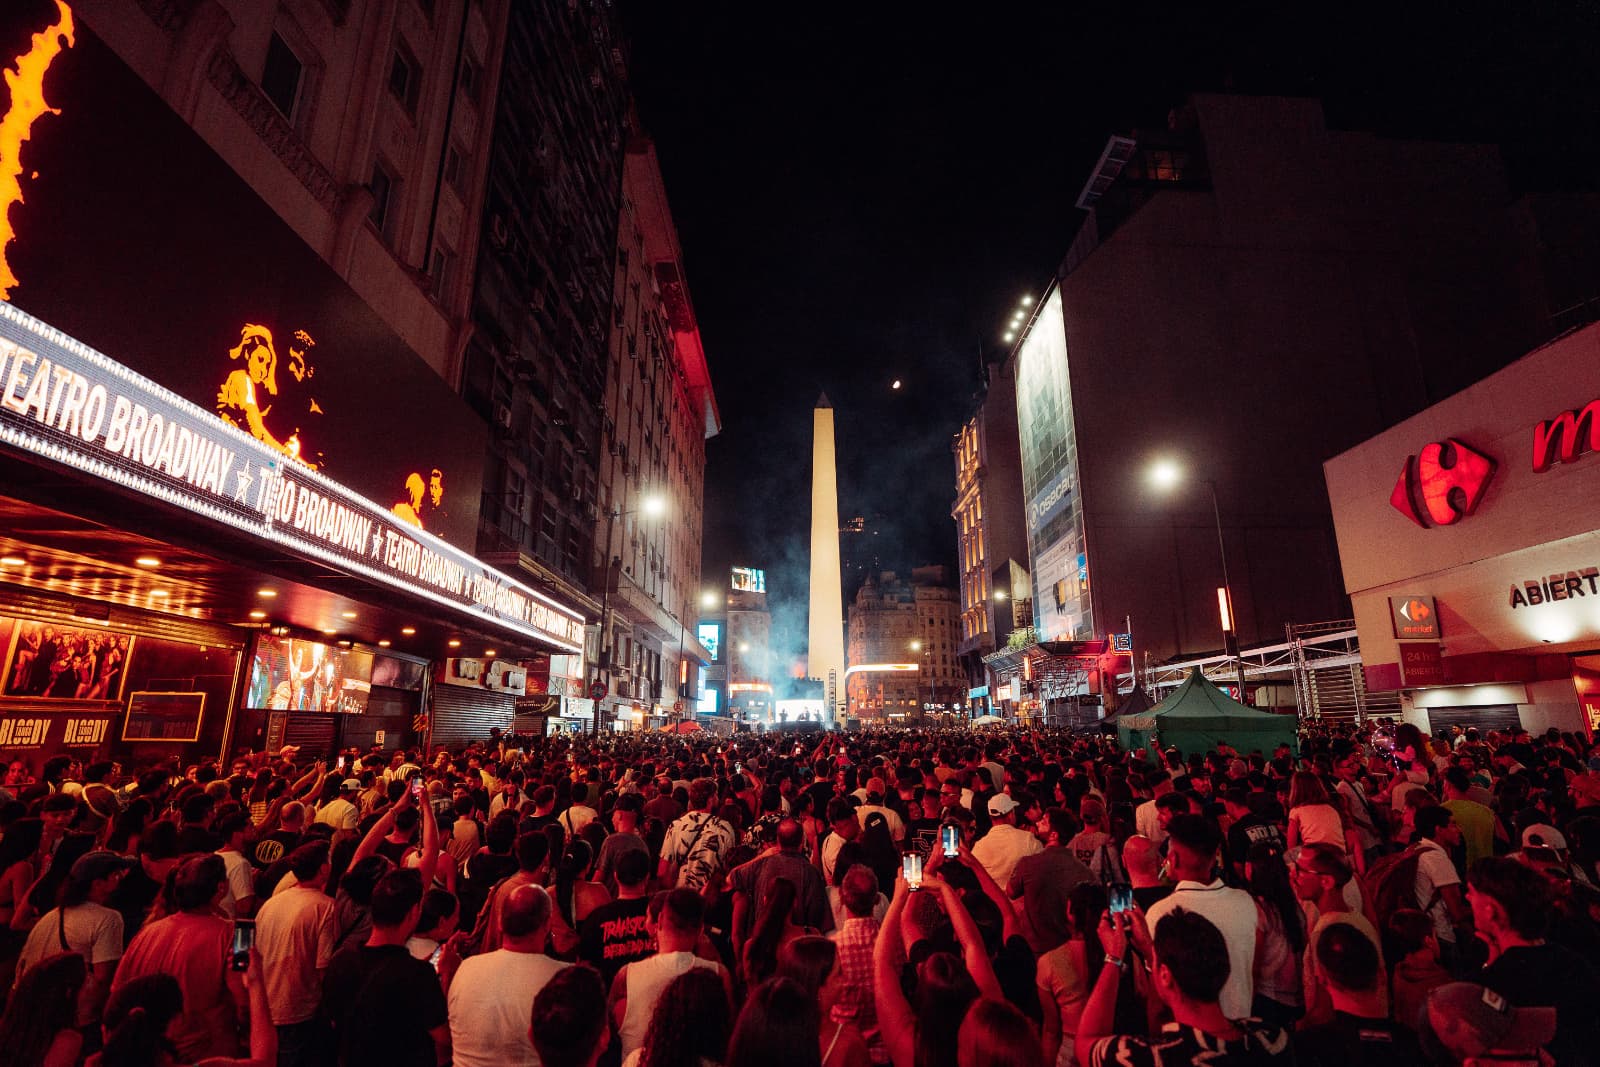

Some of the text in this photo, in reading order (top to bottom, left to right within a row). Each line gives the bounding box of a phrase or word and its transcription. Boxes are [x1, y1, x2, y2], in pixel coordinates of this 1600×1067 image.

[0, 336, 107, 441] TEATRO
[104, 394, 235, 496] BROADWAY
[294, 486, 372, 555] BROADWAY
[384, 530, 421, 577] TEATRO
[419, 547, 465, 595] BROADWAY
[1403, 624, 1433, 634] market
[0, 718, 52, 745] BLOODY
[63, 719, 109, 744] BLOODY
[257, 840, 282, 862] VANS
